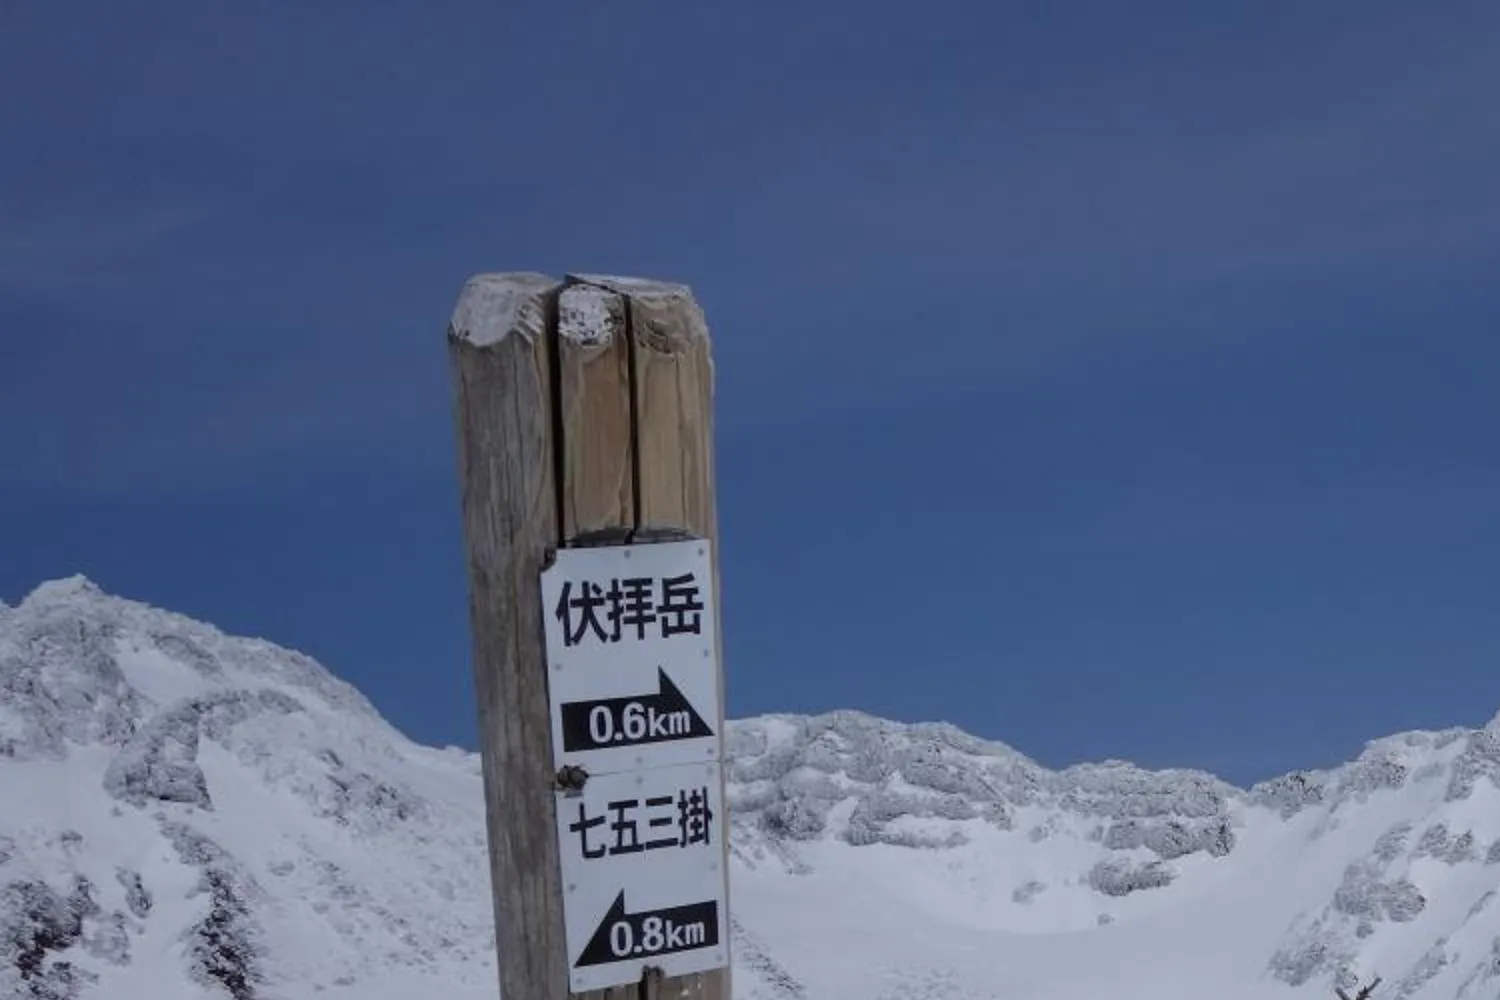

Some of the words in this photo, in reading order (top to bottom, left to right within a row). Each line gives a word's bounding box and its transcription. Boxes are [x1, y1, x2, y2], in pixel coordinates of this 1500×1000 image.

[556, 572, 703, 646] 伏拝岳
[589, 701, 691, 744] 0.6km
[570, 787, 712, 859] 七五三掛
[610, 917, 705, 957] 0.8km
